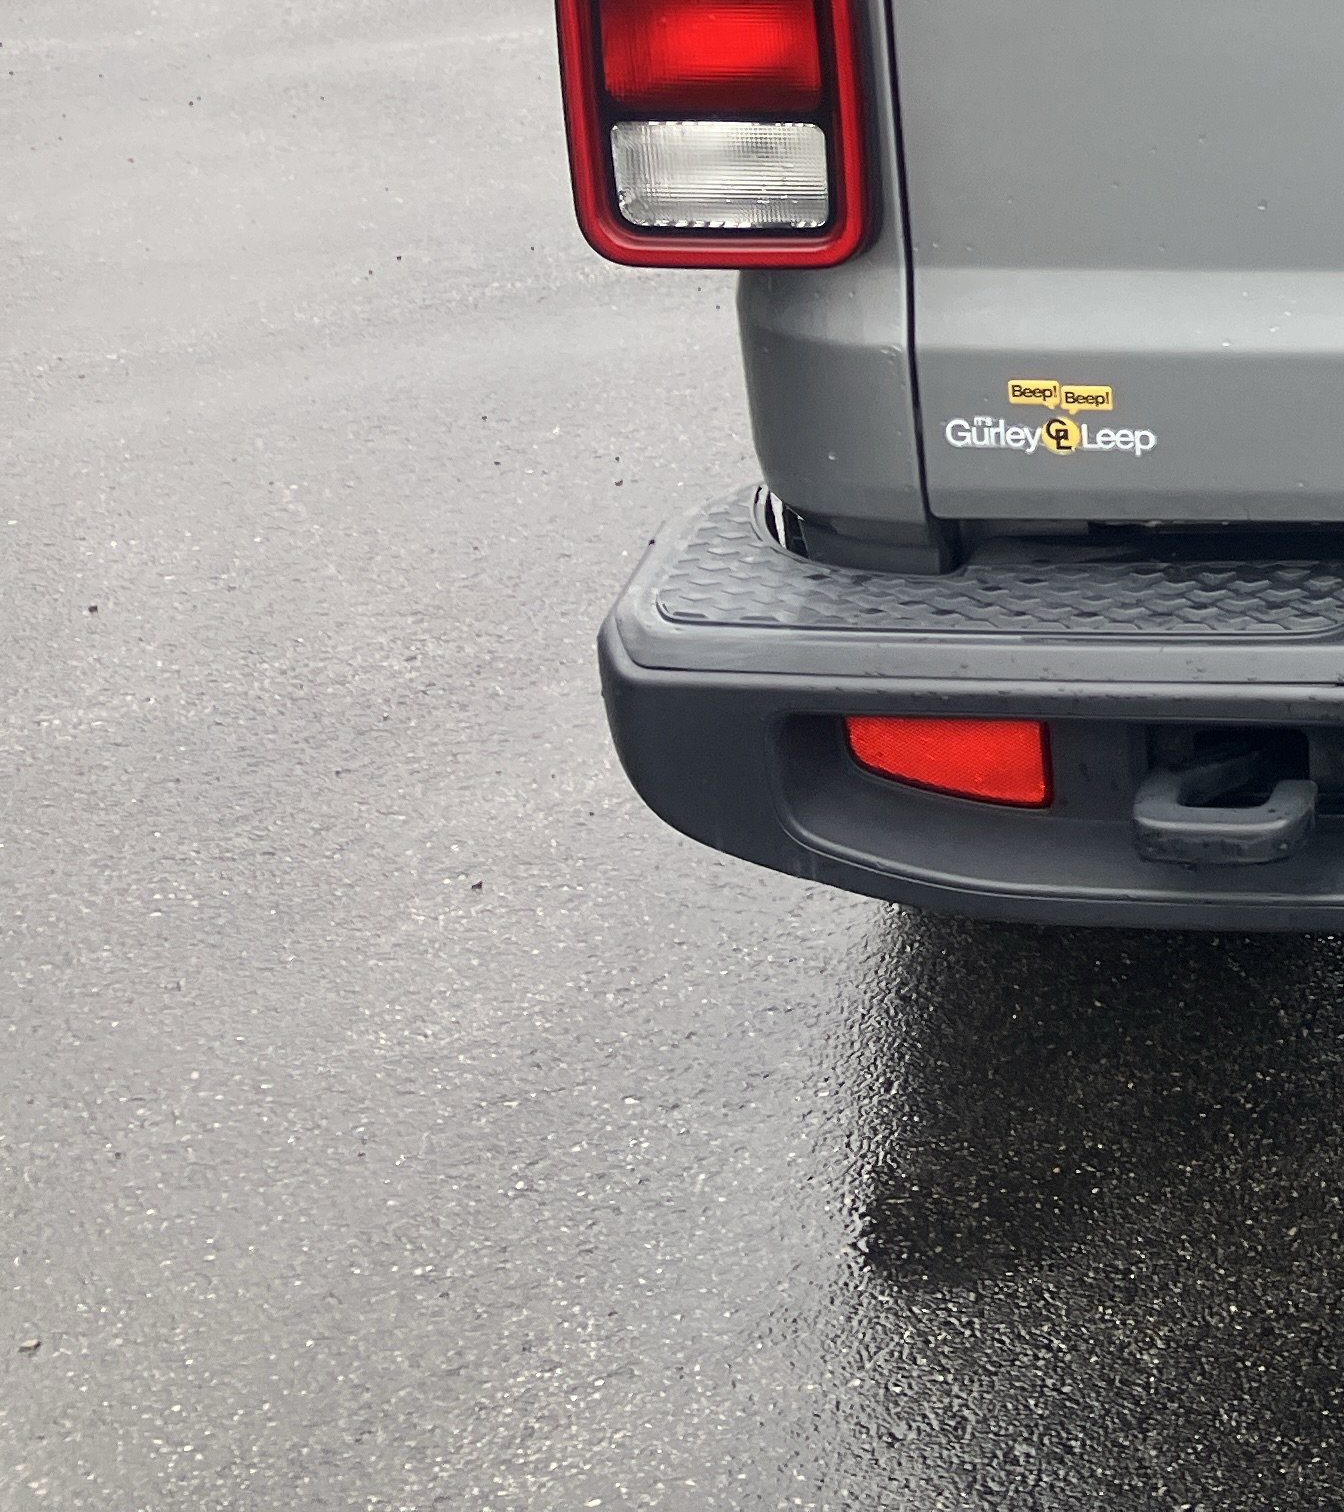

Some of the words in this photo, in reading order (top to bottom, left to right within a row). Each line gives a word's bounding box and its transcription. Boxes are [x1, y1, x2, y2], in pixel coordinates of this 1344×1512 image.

[1011, 384, 1057, 399] Beep!
[1064, 391, 1110, 406] Beep!
[945, 418, 1042, 454] Gurley
[1080, 423, 1157, 457] Leep
